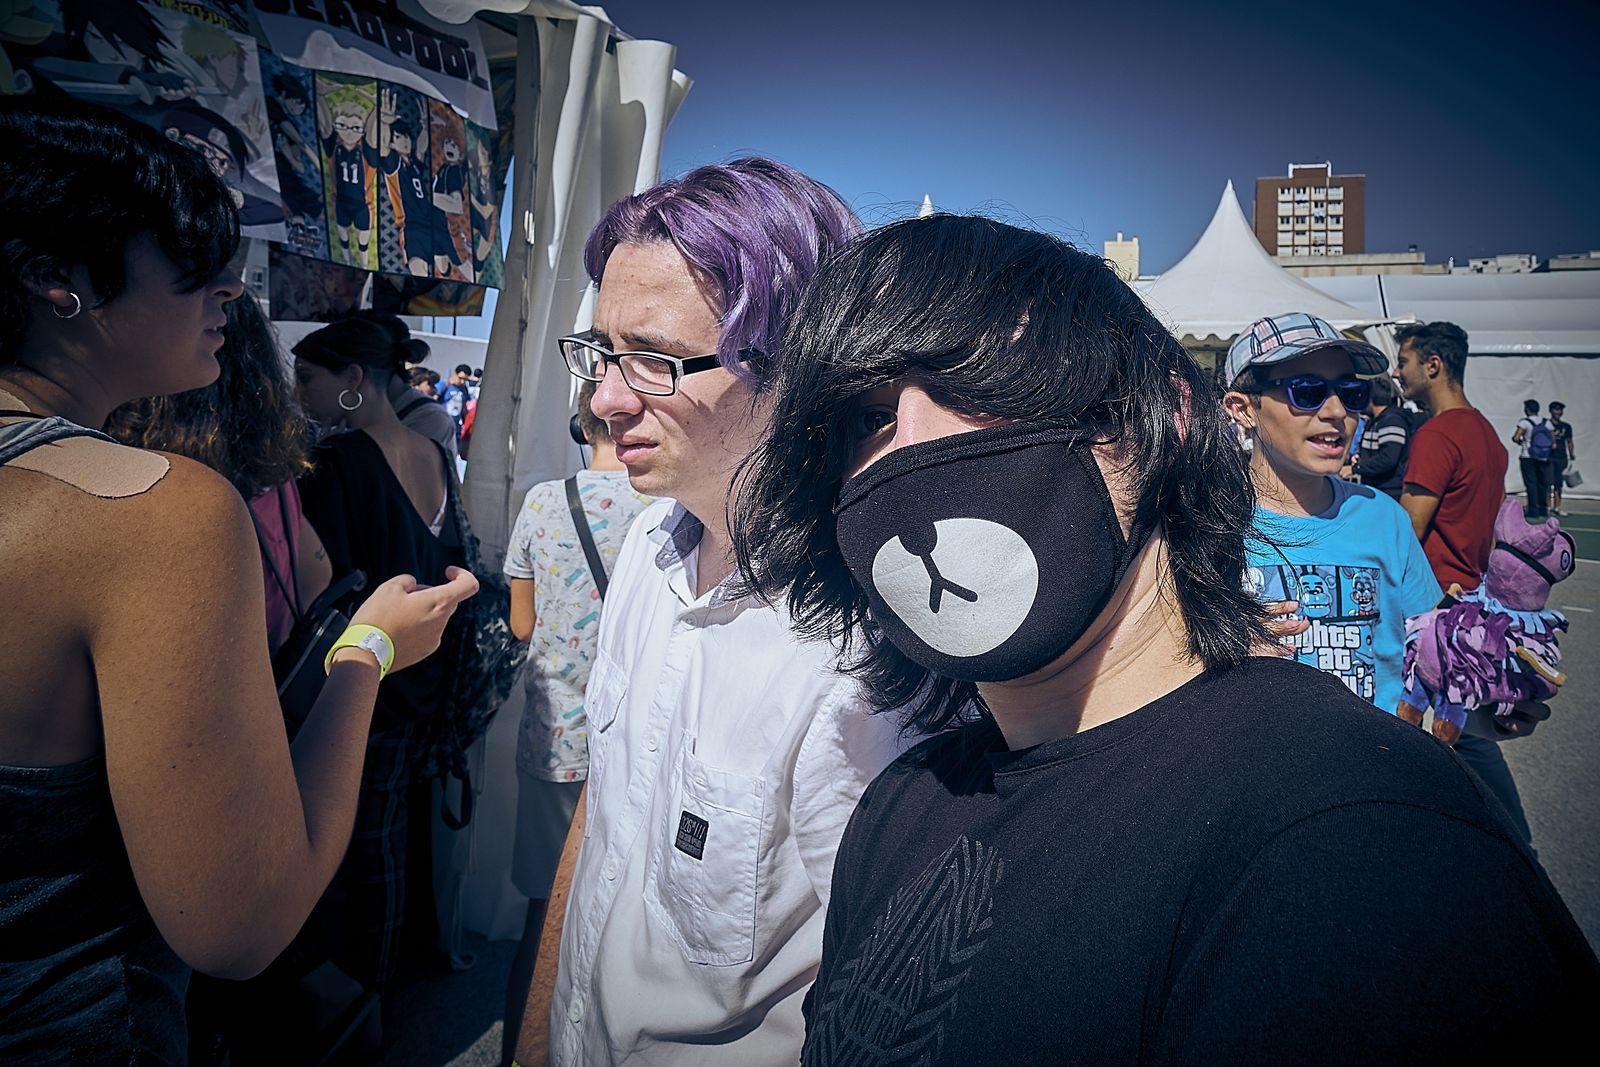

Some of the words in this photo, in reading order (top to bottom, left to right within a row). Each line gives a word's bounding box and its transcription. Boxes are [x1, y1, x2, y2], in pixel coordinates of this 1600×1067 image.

[340, 161, 359, 184] 11
[412, 177, 425, 199] 9
[1318, 647, 1351, 670] at
